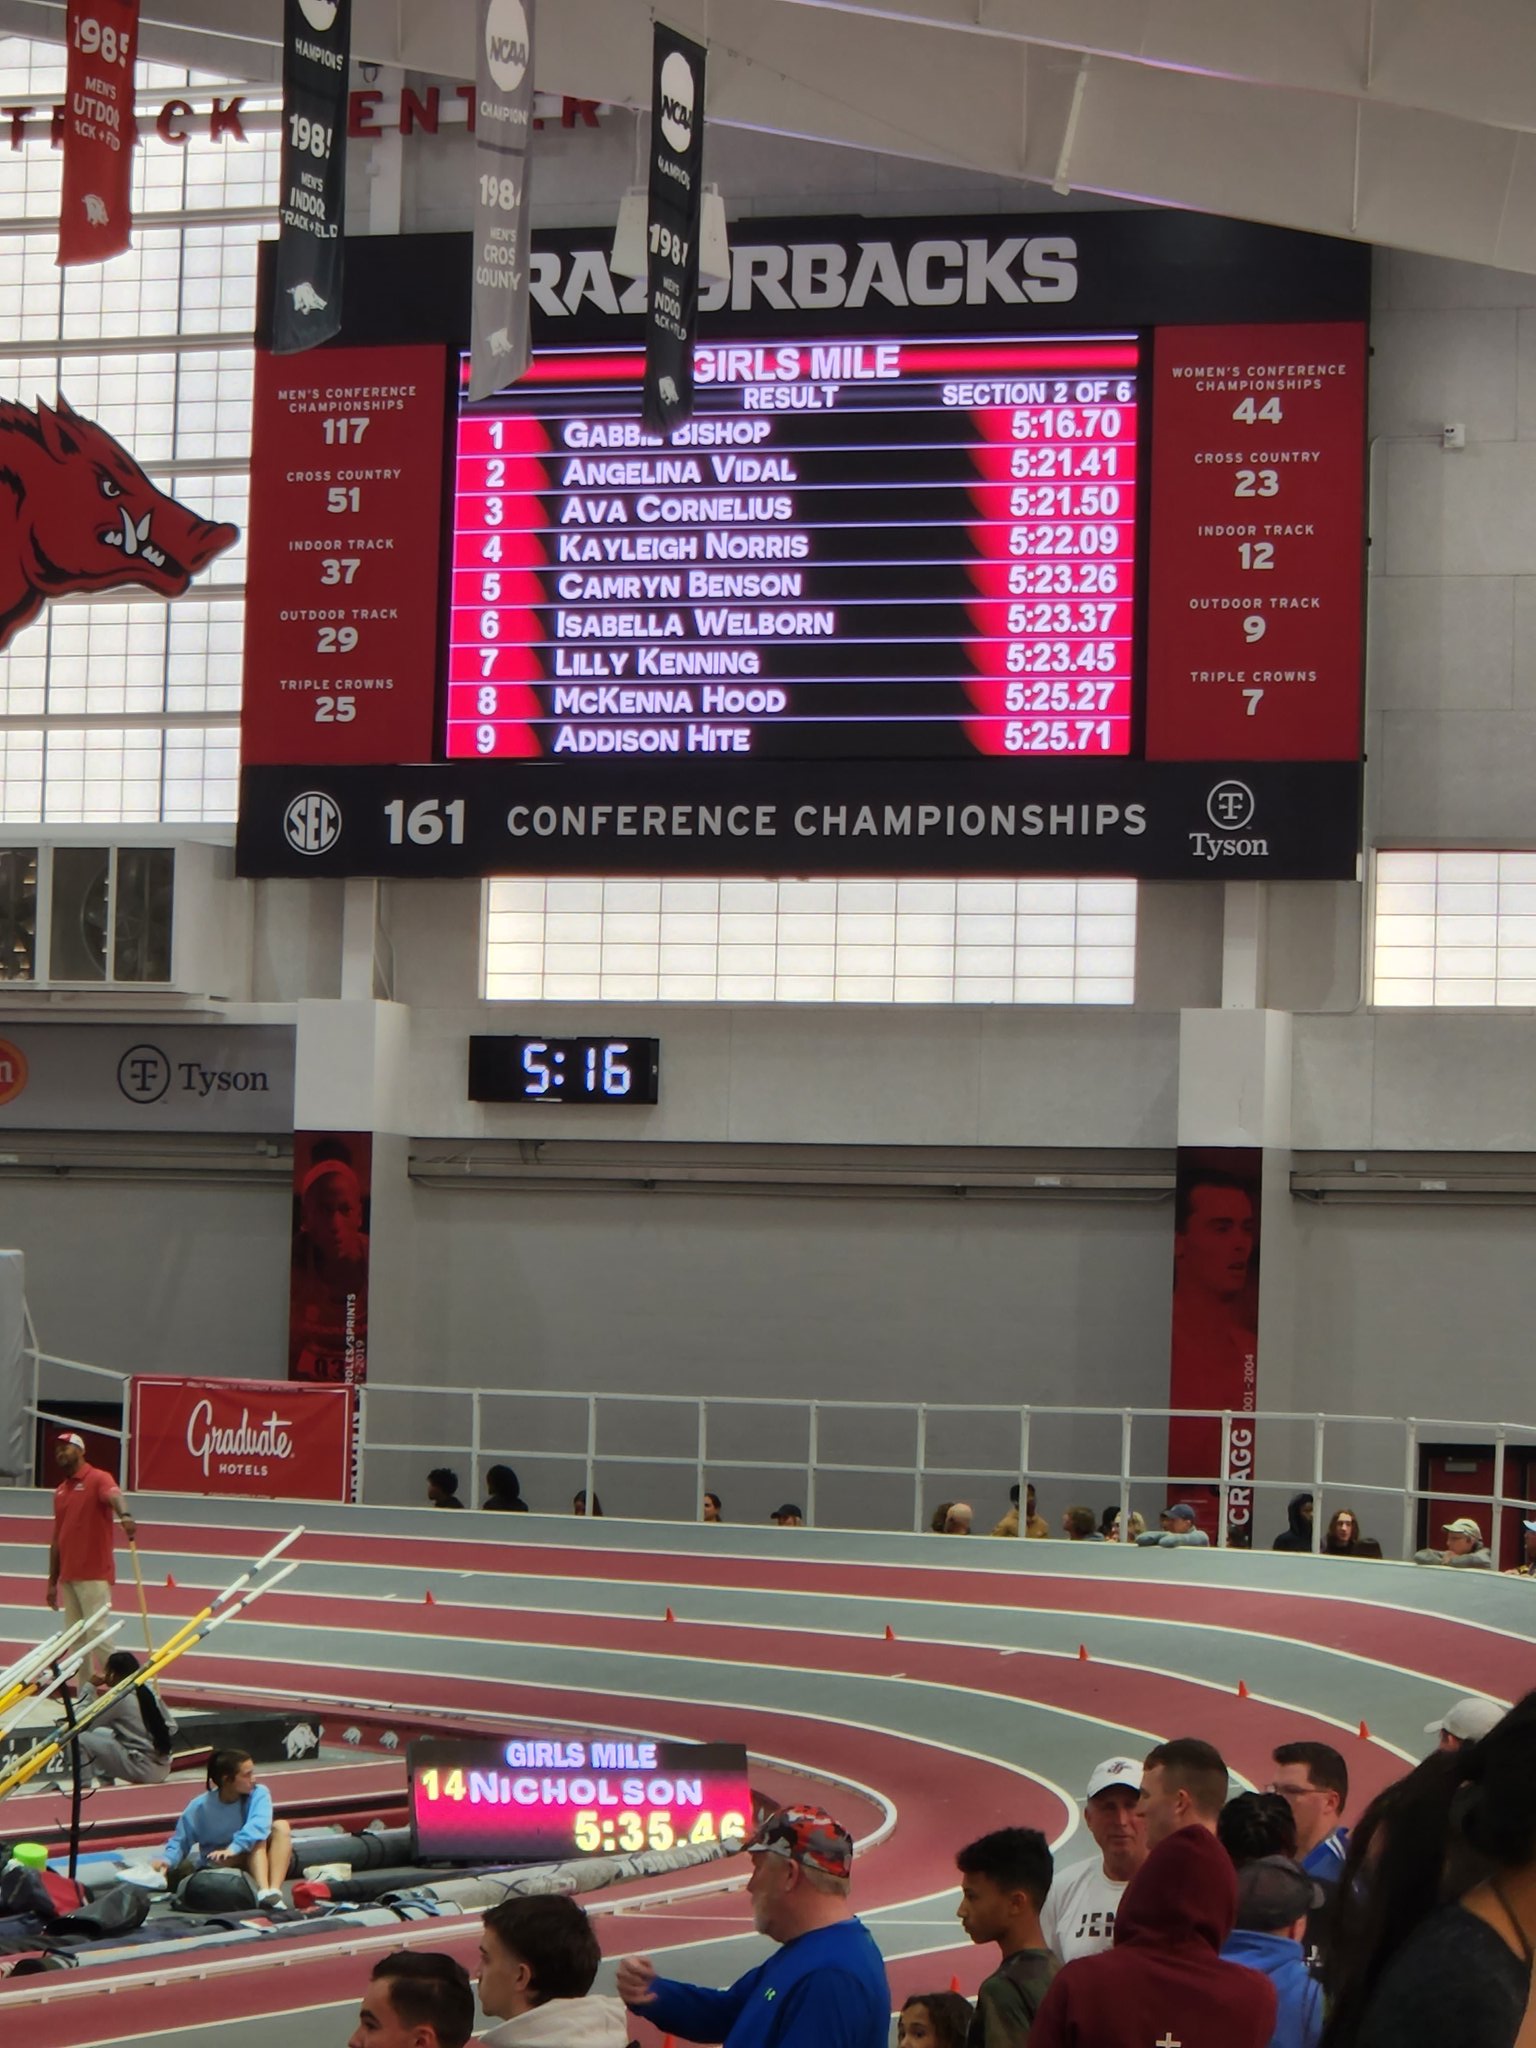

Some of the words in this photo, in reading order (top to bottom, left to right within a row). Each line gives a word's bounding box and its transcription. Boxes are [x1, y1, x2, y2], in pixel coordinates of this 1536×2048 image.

[295, 37, 343, 71] HAMPIONS
[489, 35, 527, 69] NCAA
[481, 100, 528, 125] CHAMPION
[483, 244, 516, 267] CROS
[693, 348, 801, 383] GIRLS
[810, 345, 901, 380] MILE
[1172, 367, 1240, 378] WOMEN'S
[1247, 365, 1346, 376] CONFERENCE
[278, 388, 319, 400] MEN'S
[325, 386, 416, 398] CONFERENCE
[743, 386, 840, 410] RESULT
[941, 383, 1046, 406] SECTION
[1053, 382, 1067, 404] 2
[1074, 381, 1108, 403] OF
[1115, 381, 1131, 403] 6
[1196, 379, 1322, 391] CHAMPIONSHIPS
[289, 400, 404, 413] CHAMPIONSHIPS
[1232, 397, 1283, 425] 44
[322, 417, 369, 444] 117
[488, 421, 503, 450] 1
[1011, 409, 1121, 440] 5:16.70
[486, 459, 505, 488] 2
[1010, 447, 1117, 479] 5:21.41
[1194, 452, 1243, 464] CROSS
[1250, 451, 1320, 463] COUNTRY
[287, 471, 331, 482] CROSS
[337, 469, 401, 480] COUNTRY
[1234, 470, 1280, 497] 23
[326, 487, 360, 513] 51
[484, 496, 503, 526] 3
[1009, 486, 1120, 517] 5:21.50
[482, 535, 502, 563] 4
[1009, 525, 1119, 556] 5:22.09
[1198, 525, 1257, 537] INDOOR
[1264, 525, 1315, 536] TRACK
[289, 541, 342, 551] INDOOR
[348, 539, 394, 549] TRACK
[1238, 542, 1275, 570] 12
[320, 559, 360, 584] 37
[481, 572, 500, 601] 5
[1008, 564, 1118, 594] 5:23.26
[280, 610, 345, 621] OUTDOOR
[351, 609, 398, 619] TRACK
[1189, 598, 1262, 609] OUTDOOR
[1270, 598, 1320, 609] TRACK
[480, 610, 499, 640] 6
[1007, 603, 1117, 634] 5:23.37
[1243, 615, 1266, 643] 9
[317, 626, 358, 653] 29
[479, 648, 499, 677] 7
[1006, 643, 1116, 673] 5:23.45
[280, 680, 330, 690] TRIPLE
[335, 679, 394, 690] CROWNS
[1190, 671, 1245, 683] TRIPLE
[1252, 671, 1317, 682] CROWNS
[315, 696, 356, 722] 25
[477, 686, 497, 715] 8
[1004, 682, 1115, 712] 5:25.27
[1241, 689, 1264, 715] 7
[476, 724, 496, 753] 9
[1003, 721, 1111, 752] 5:25.71
[287, 794, 339, 852] SEC
[384, 799, 464, 845] 161
[507, 804, 777, 836] CONFERENCE
[794, 803, 1147, 836] CHAMPIONSHIPS
[1189, 833, 1269, 861] Tyson
[178, 1063, 269, 1096] Tyson
[523, 1043, 631, 1094] 5:16
[187, 1399, 293, 1477] Graduate
[219, 1463, 268, 1476] HOTELS
[1229, 1428, 1252, 1526] CRAGG
[506, 1742, 585, 1768] GIRLS
[591, 1743, 657, 1769] MILE
[421, 1769, 467, 1801] 14
